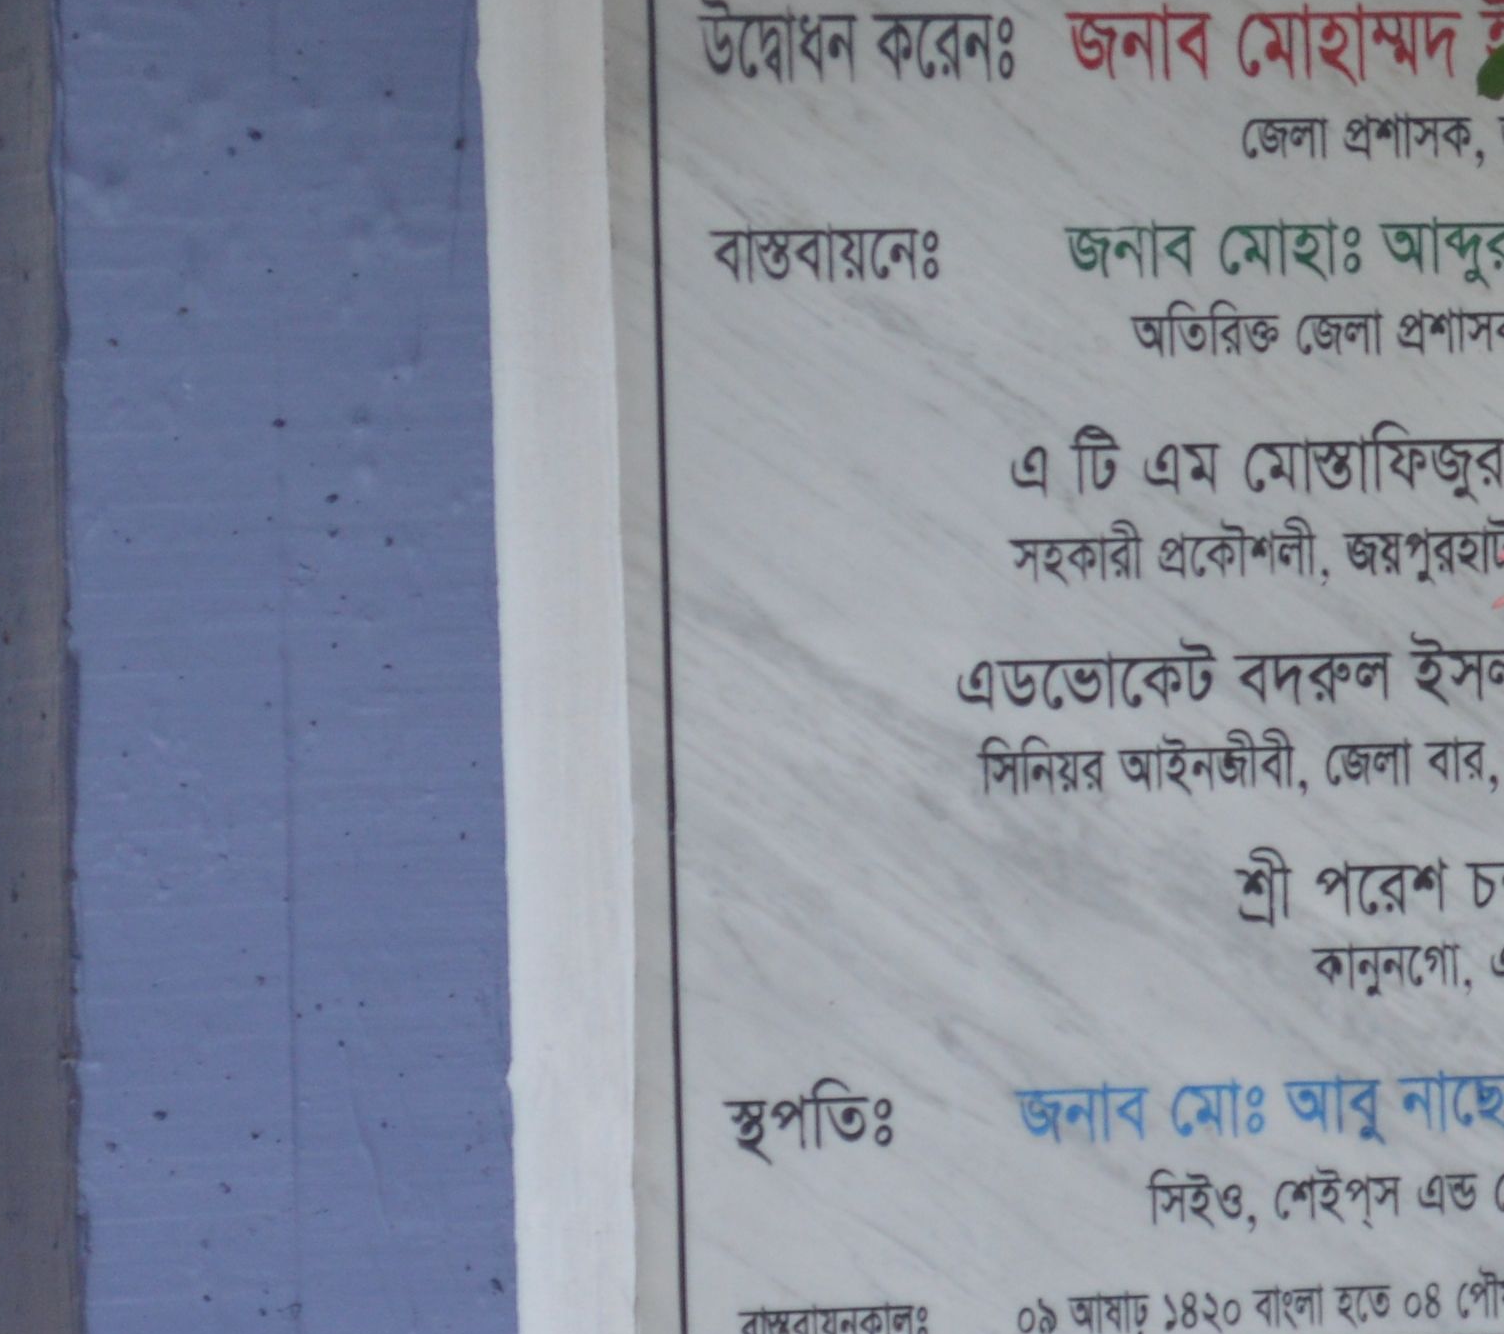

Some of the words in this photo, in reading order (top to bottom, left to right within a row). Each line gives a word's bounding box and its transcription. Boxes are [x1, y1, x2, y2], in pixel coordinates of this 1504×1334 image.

[872, 14, 1015, 81] করেনঃ
[1065, 3, 1212, 80] জনাব
[1238, 3, 1461, 85] মোহাম্মদ
[1242, 118, 1328, 159] জেলা
[1344, 113, 1484, 167] প্রশাসক,
[709, 225, 939, 282] বাস্তবায়নেঃ
[1064, 220, 1196, 278] জনাব
[1219, 219, 1361, 281] মোহাঃ
[1130, 299, 1279, 357] অতিরিক্ত
[1297, 310, 1384, 355] জেলা
[1011, 446, 1048, 495] এ
[1070, 424, 1120, 494] টি
[1144, 443, 1220, 494] এম
[1008, 519, 1143, 584] সহকারী
[1158, 514, 1331, 587] প্রকৌশলী,
[957, 638, 1217, 710] এডভোকেট
[1233, 652, 1392, 705] বদরুল
[976, 735, 1105, 795] সিনিয়র
[1117, 727, 1308, 795] আইনজীবী,
[1326, 738, 1412, 786] জেলা
[1424, 737, 1498, 793] বার,
[1234, 846, 1292, 928] শ্রী
[1316, 857, 1448, 915] পরেশ
[1311, 943, 1472, 997] কানুনগো,
[1013, 1083, 1149, 1143] জনাব
[1171, 1079, 1265, 1137] মোঃ
[1284, 1075, 1385, 1144] আবু
[1146, 1168, 1256, 1232] সিইও,
[1418, 1173, 1477, 1214] এন্ড
[1018, 1298, 1057, 1334] ০৯
[1164, 1291, 1241, 1332] ১৪২০
[1252, 1285, 1323, 1328] বাংলা
[1333, 1285, 1391, 1325] হতে
[1404, 1282, 1441, 1318] ০৪
